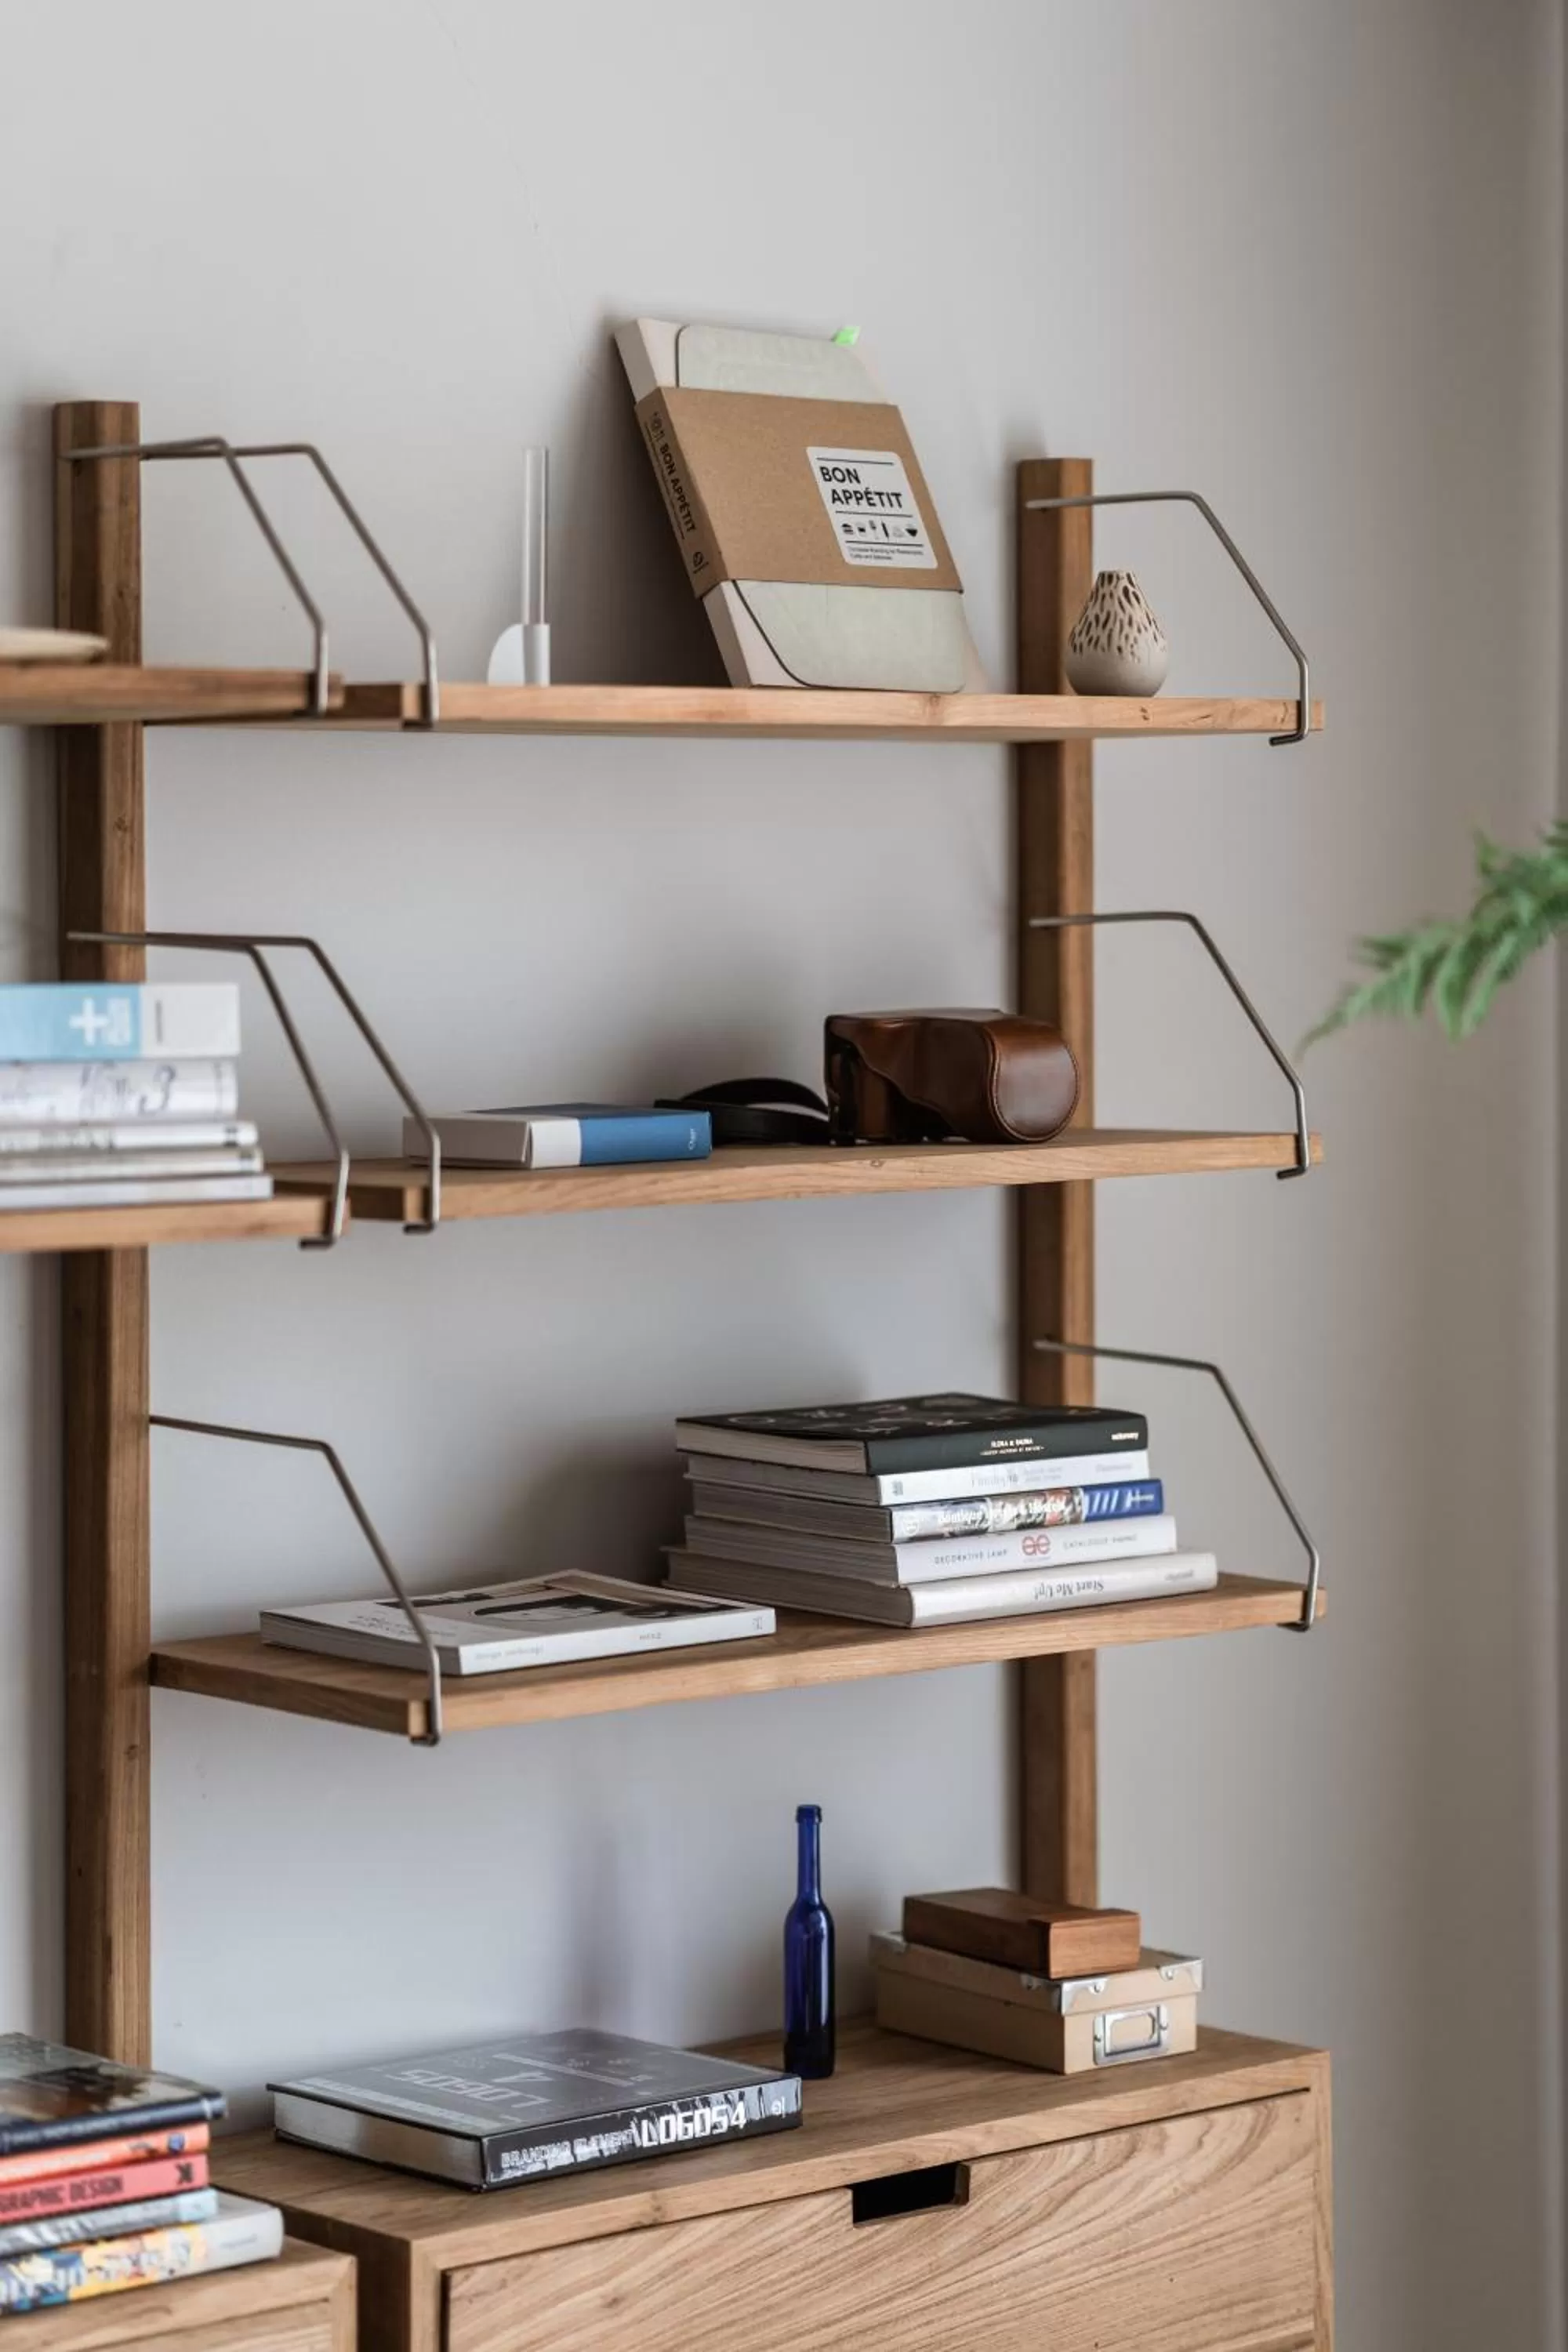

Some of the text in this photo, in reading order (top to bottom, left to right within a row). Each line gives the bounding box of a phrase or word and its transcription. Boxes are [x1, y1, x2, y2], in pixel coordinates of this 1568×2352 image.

[819, 466, 861, 485] BON
[659, 443, 696, 532] BON APPÉTIT
[831, 487, 902, 508] APPÉTIT
[1057, 1582, 1074, 1596] Me
[1076, 1579, 1105, 1594] Start
[69, 2176, 124, 2203] DESIGN
